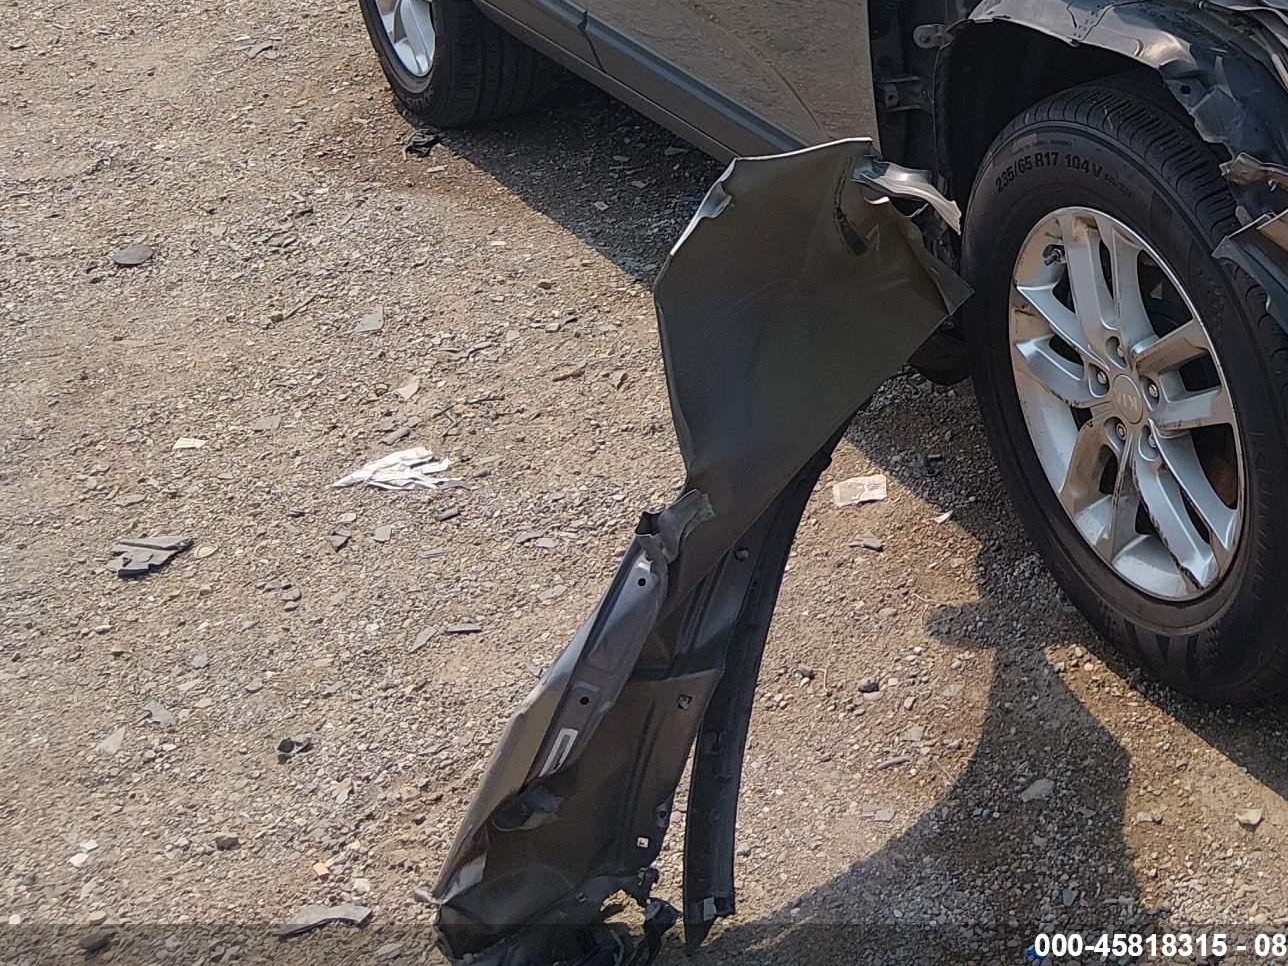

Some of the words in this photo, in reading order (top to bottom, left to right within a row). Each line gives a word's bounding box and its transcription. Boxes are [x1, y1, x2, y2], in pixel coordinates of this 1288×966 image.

[994, 153, 1034, 194] 235/65
[1033, 151, 1059, 169] R17
[1064, 152, 1090, 173] 104
